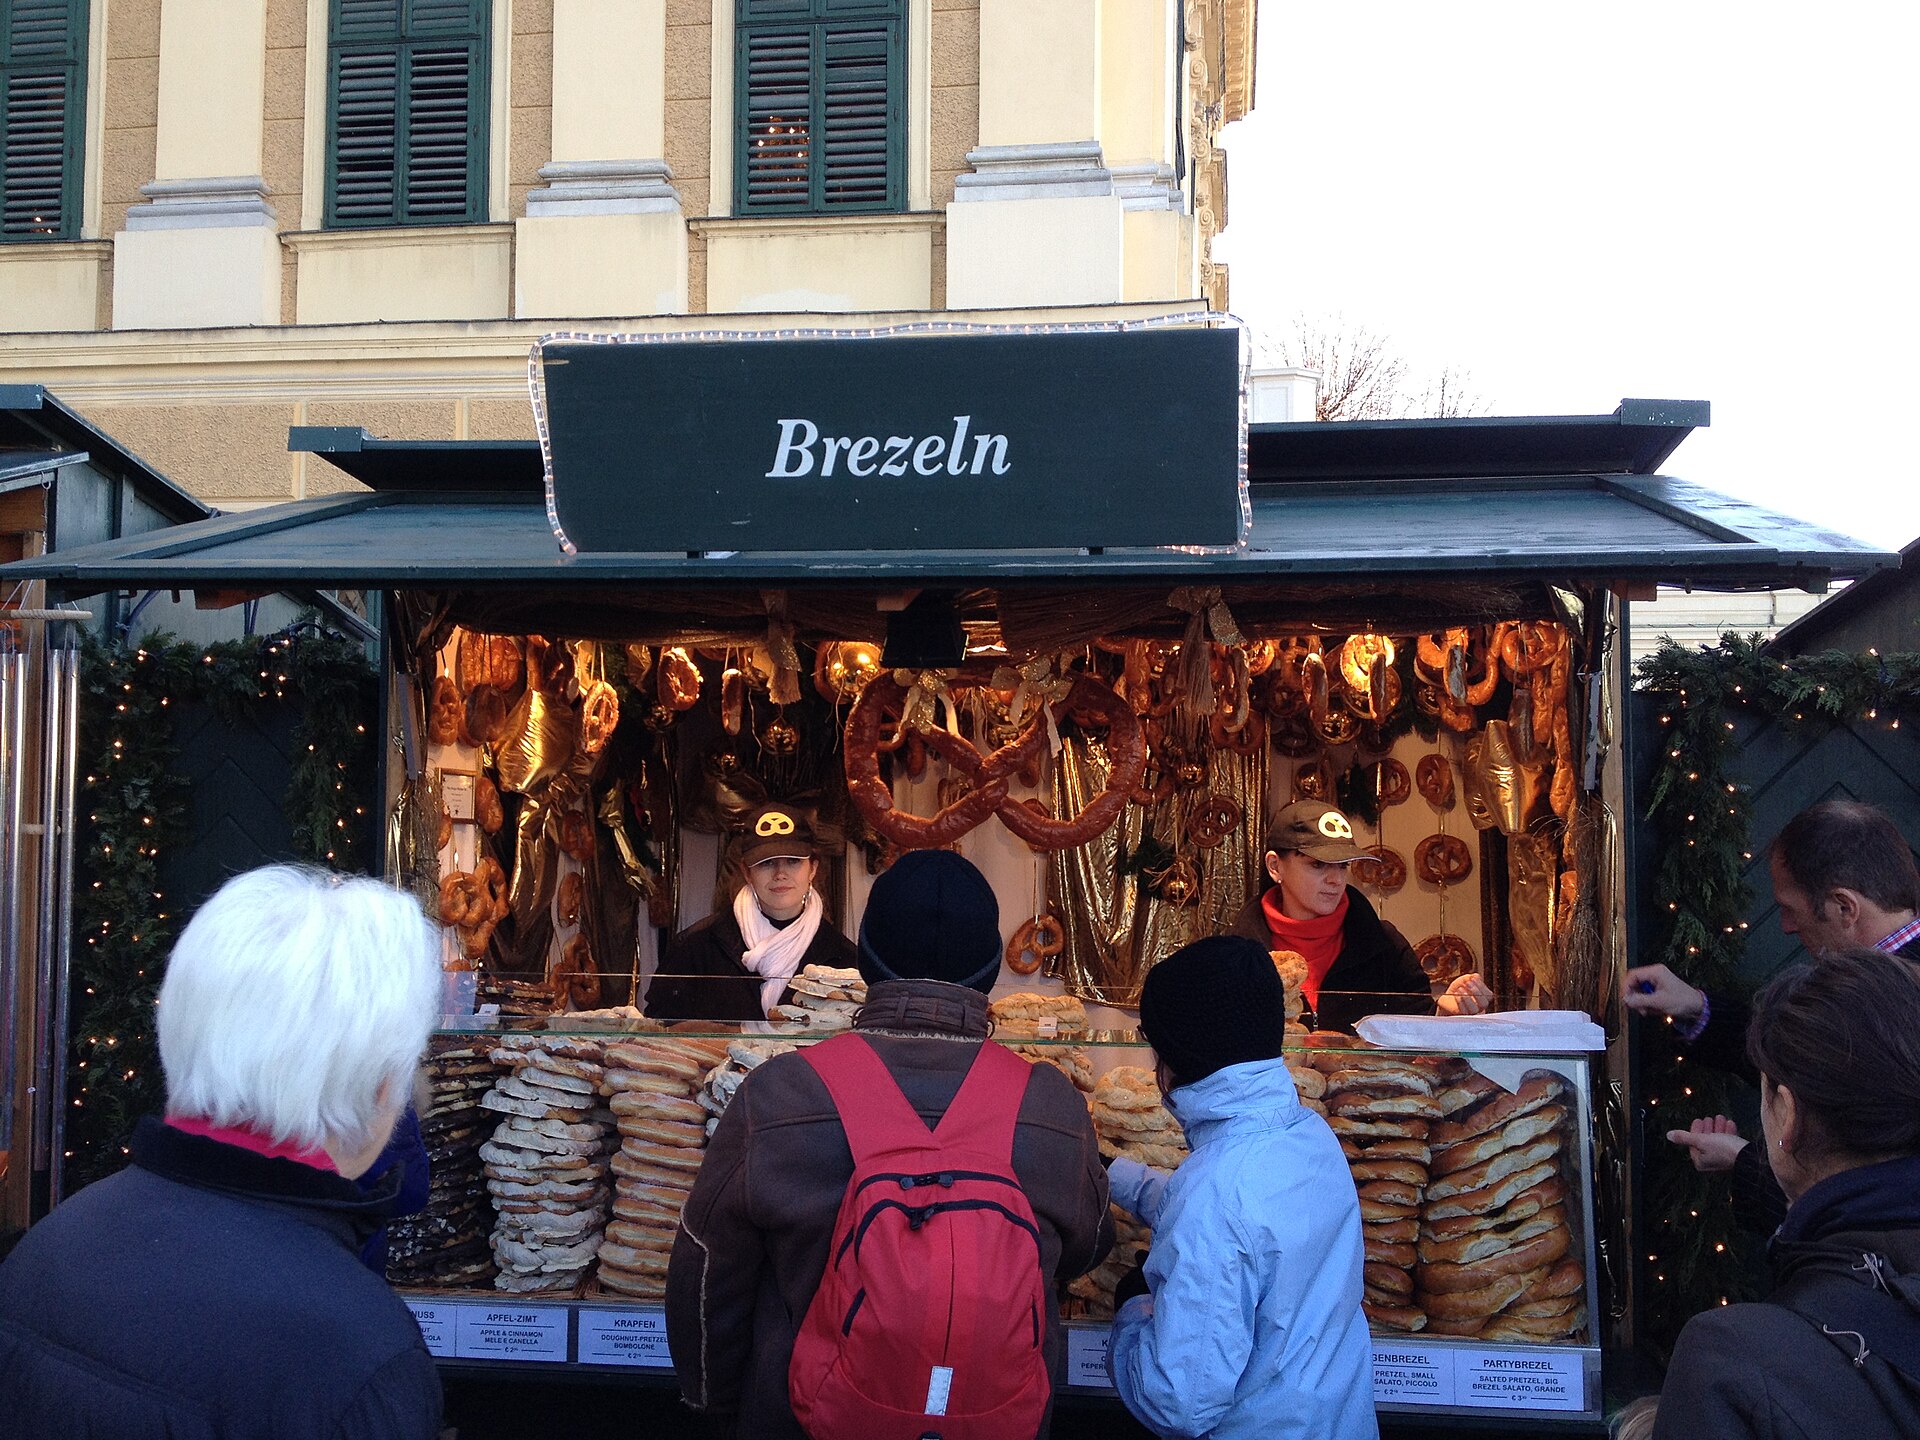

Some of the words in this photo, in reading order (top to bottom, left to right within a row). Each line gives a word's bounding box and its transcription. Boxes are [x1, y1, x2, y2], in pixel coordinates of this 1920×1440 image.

[765, 415, 1011, 477] Brezeln
[487, 1313, 537, 1323] APFEL-ZIMT
[614, 1319, 656, 1328] KRAPFEN
[614, 1342, 655, 1350] BOMBOLONE
[1081, 1362, 1106, 1370] PEPER
[1483, 1359, 1553, 1370] PARTYBREZEL
[1374, 1378, 1404, 1386] SALATO,
[1479, 1375, 1507, 1383] SALTED
[1508, 1376, 1543, 1385] PRETZEL,
[1472, 1383, 1500, 1391] BREZEL
[1502, 1384, 1532, 1392] SALATO,
[1534, 1385, 1565, 1393] GRANDE
